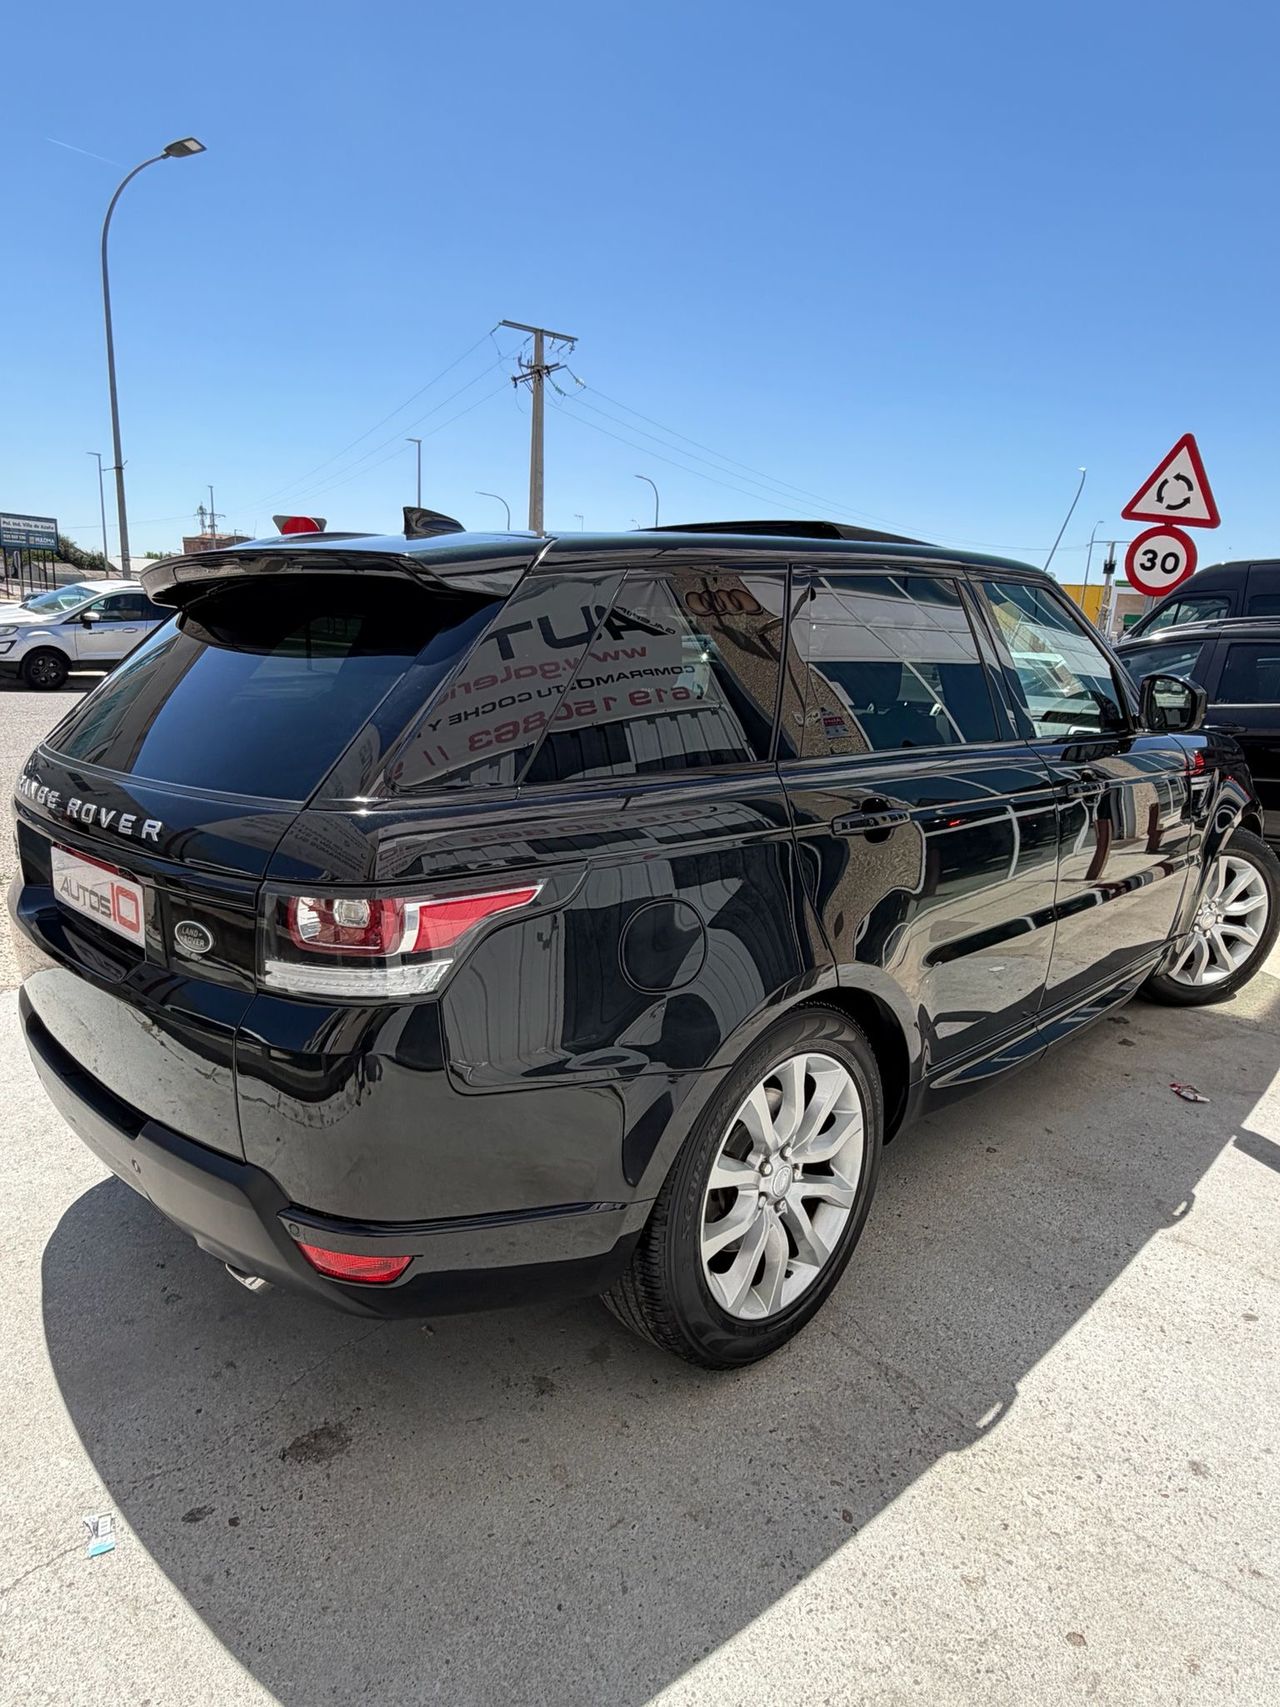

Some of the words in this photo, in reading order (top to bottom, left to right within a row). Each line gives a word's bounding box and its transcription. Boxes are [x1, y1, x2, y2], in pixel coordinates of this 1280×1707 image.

[1139, 548, 1180, 575] 30
[66, 797, 163, 842] ROVER
[181, 926, 199, 938] LAND
